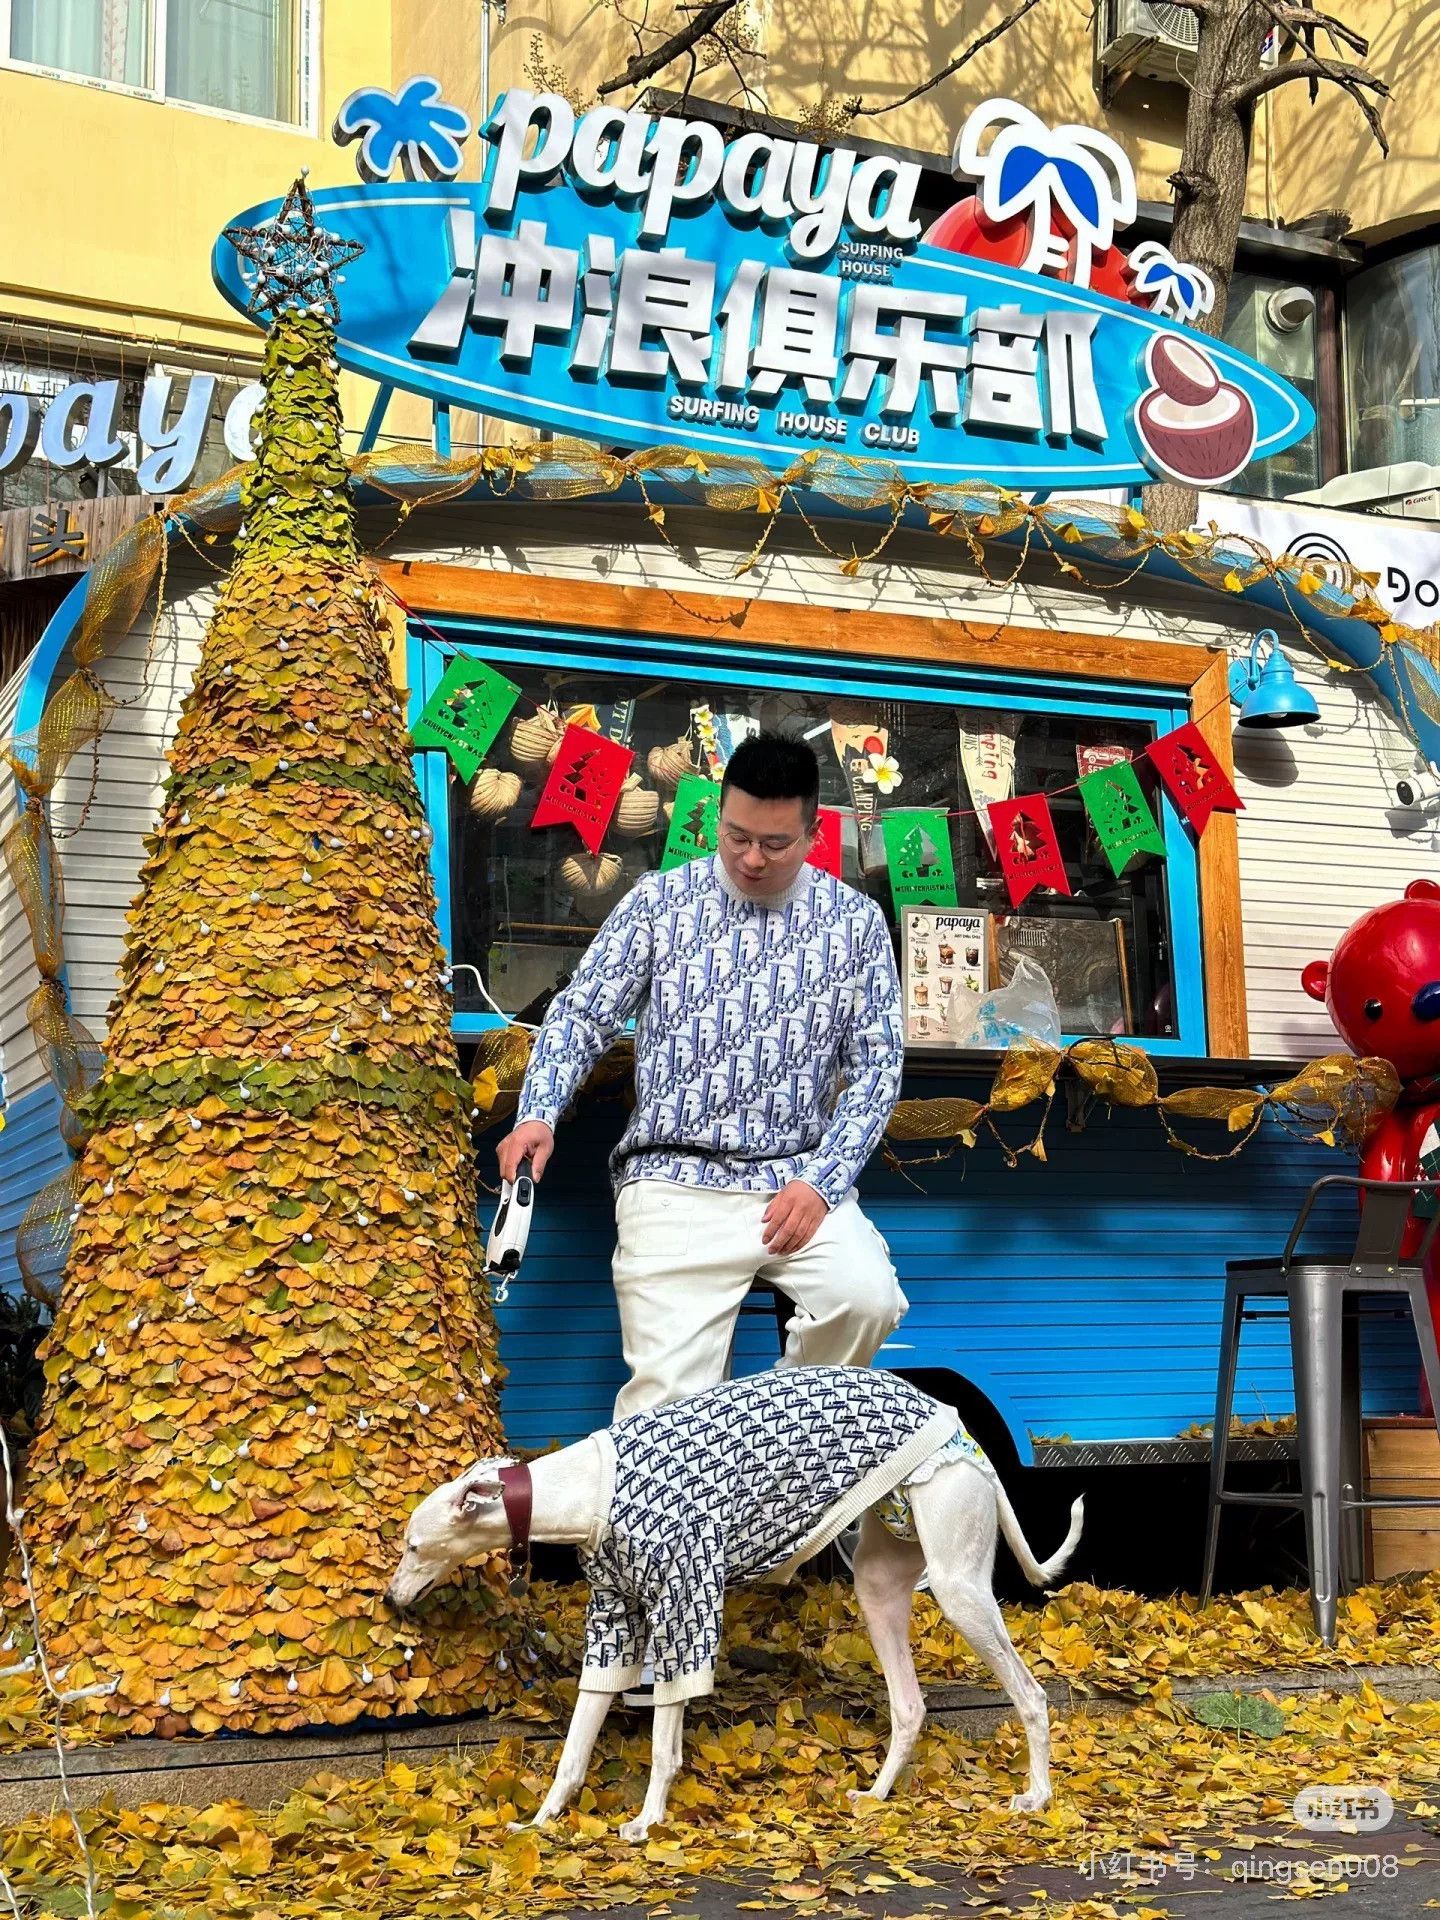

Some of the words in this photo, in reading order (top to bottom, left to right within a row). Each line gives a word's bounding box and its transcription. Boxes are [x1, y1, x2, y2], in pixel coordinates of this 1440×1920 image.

[486, 87, 922, 258] papaya
[841, 242, 904, 259] SURFING
[841, 260, 891, 277] HOUSE
[409, 206, 1108, 440] 冲浪俱乐部
[669, 396, 760, 425] SURFING
[779, 412, 848, 437] HOUSE
[864, 422, 919, 445] CLUB
[935, 916, 981, 931] papaya
